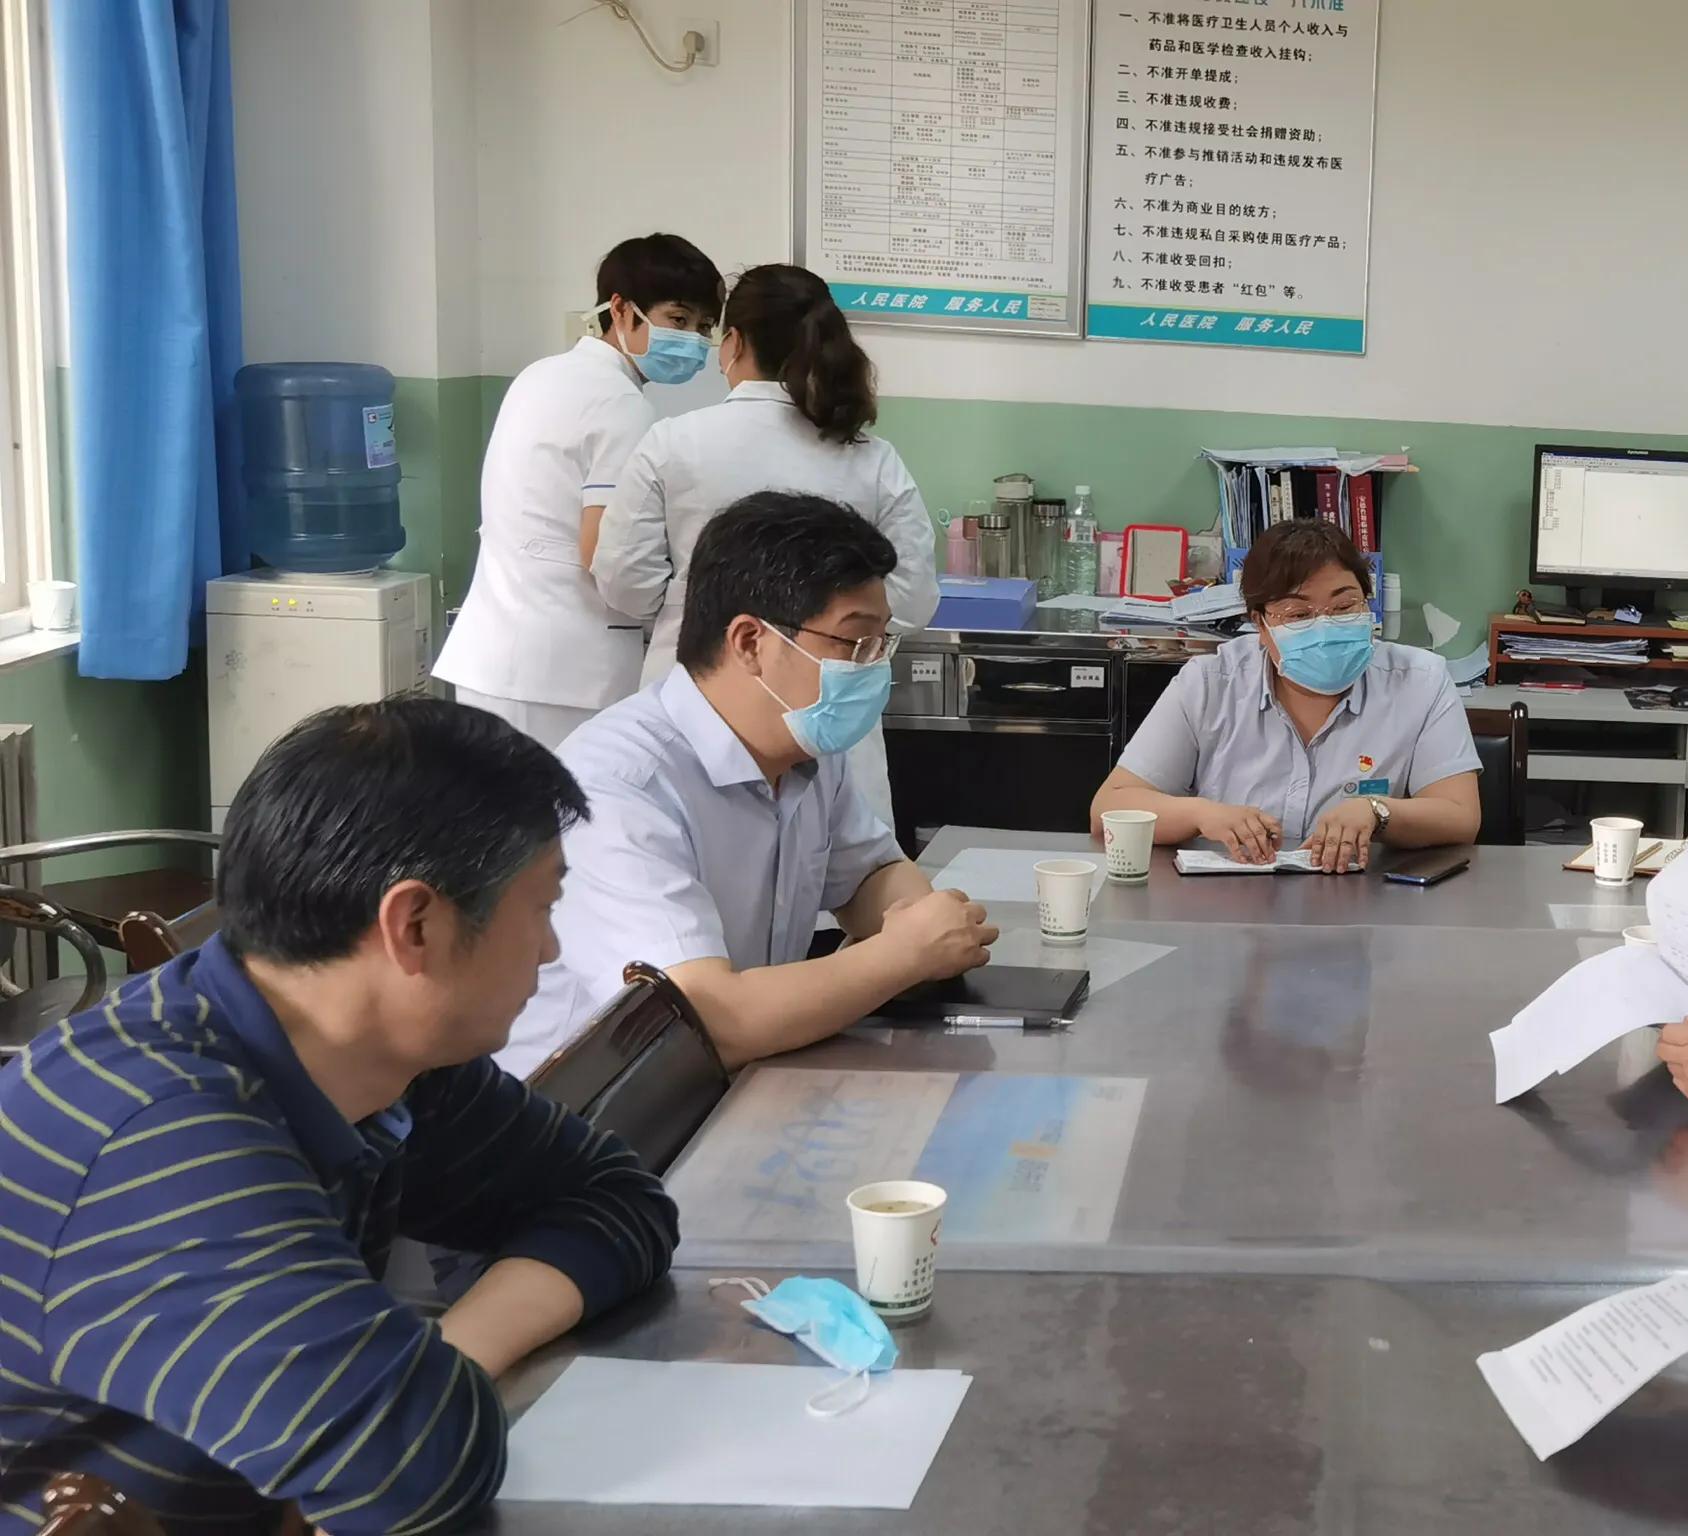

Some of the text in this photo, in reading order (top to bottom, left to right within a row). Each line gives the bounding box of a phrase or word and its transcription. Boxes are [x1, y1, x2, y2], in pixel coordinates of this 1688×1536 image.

[1119, 11, 1349, 37] 一、不准将医疗卫生人员个人收入与
[1115, 144, 1344, 171] 五、不准参与推销活动和违规发布医
[851, 291, 929, 310] 人民医院
[944, 296, 1023, 315] 服务人民
[1140, 312, 1315, 336] 人民医院 服务人民
